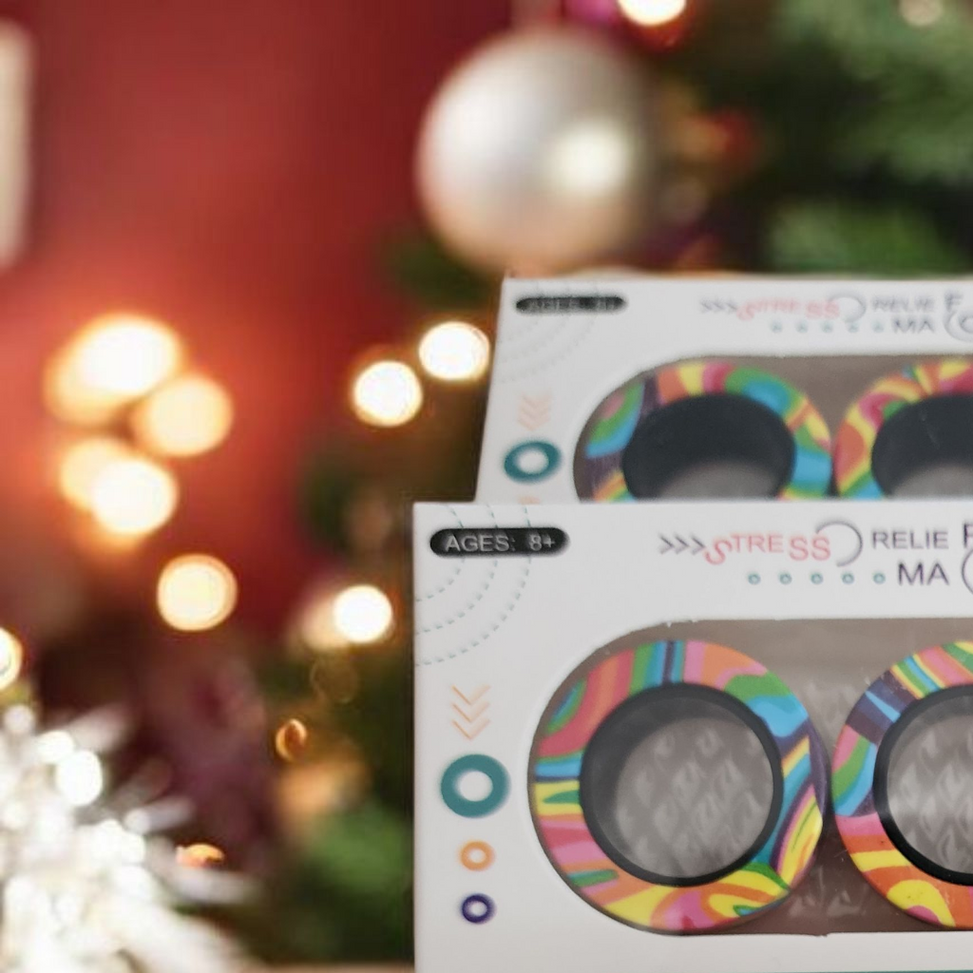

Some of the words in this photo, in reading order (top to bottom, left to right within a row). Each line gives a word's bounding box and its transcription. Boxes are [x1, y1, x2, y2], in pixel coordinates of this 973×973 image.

[444, 534, 515, 551] AGES:
[529, 534, 555, 550] 8+
[703, 533, 831, 565] STRESS
